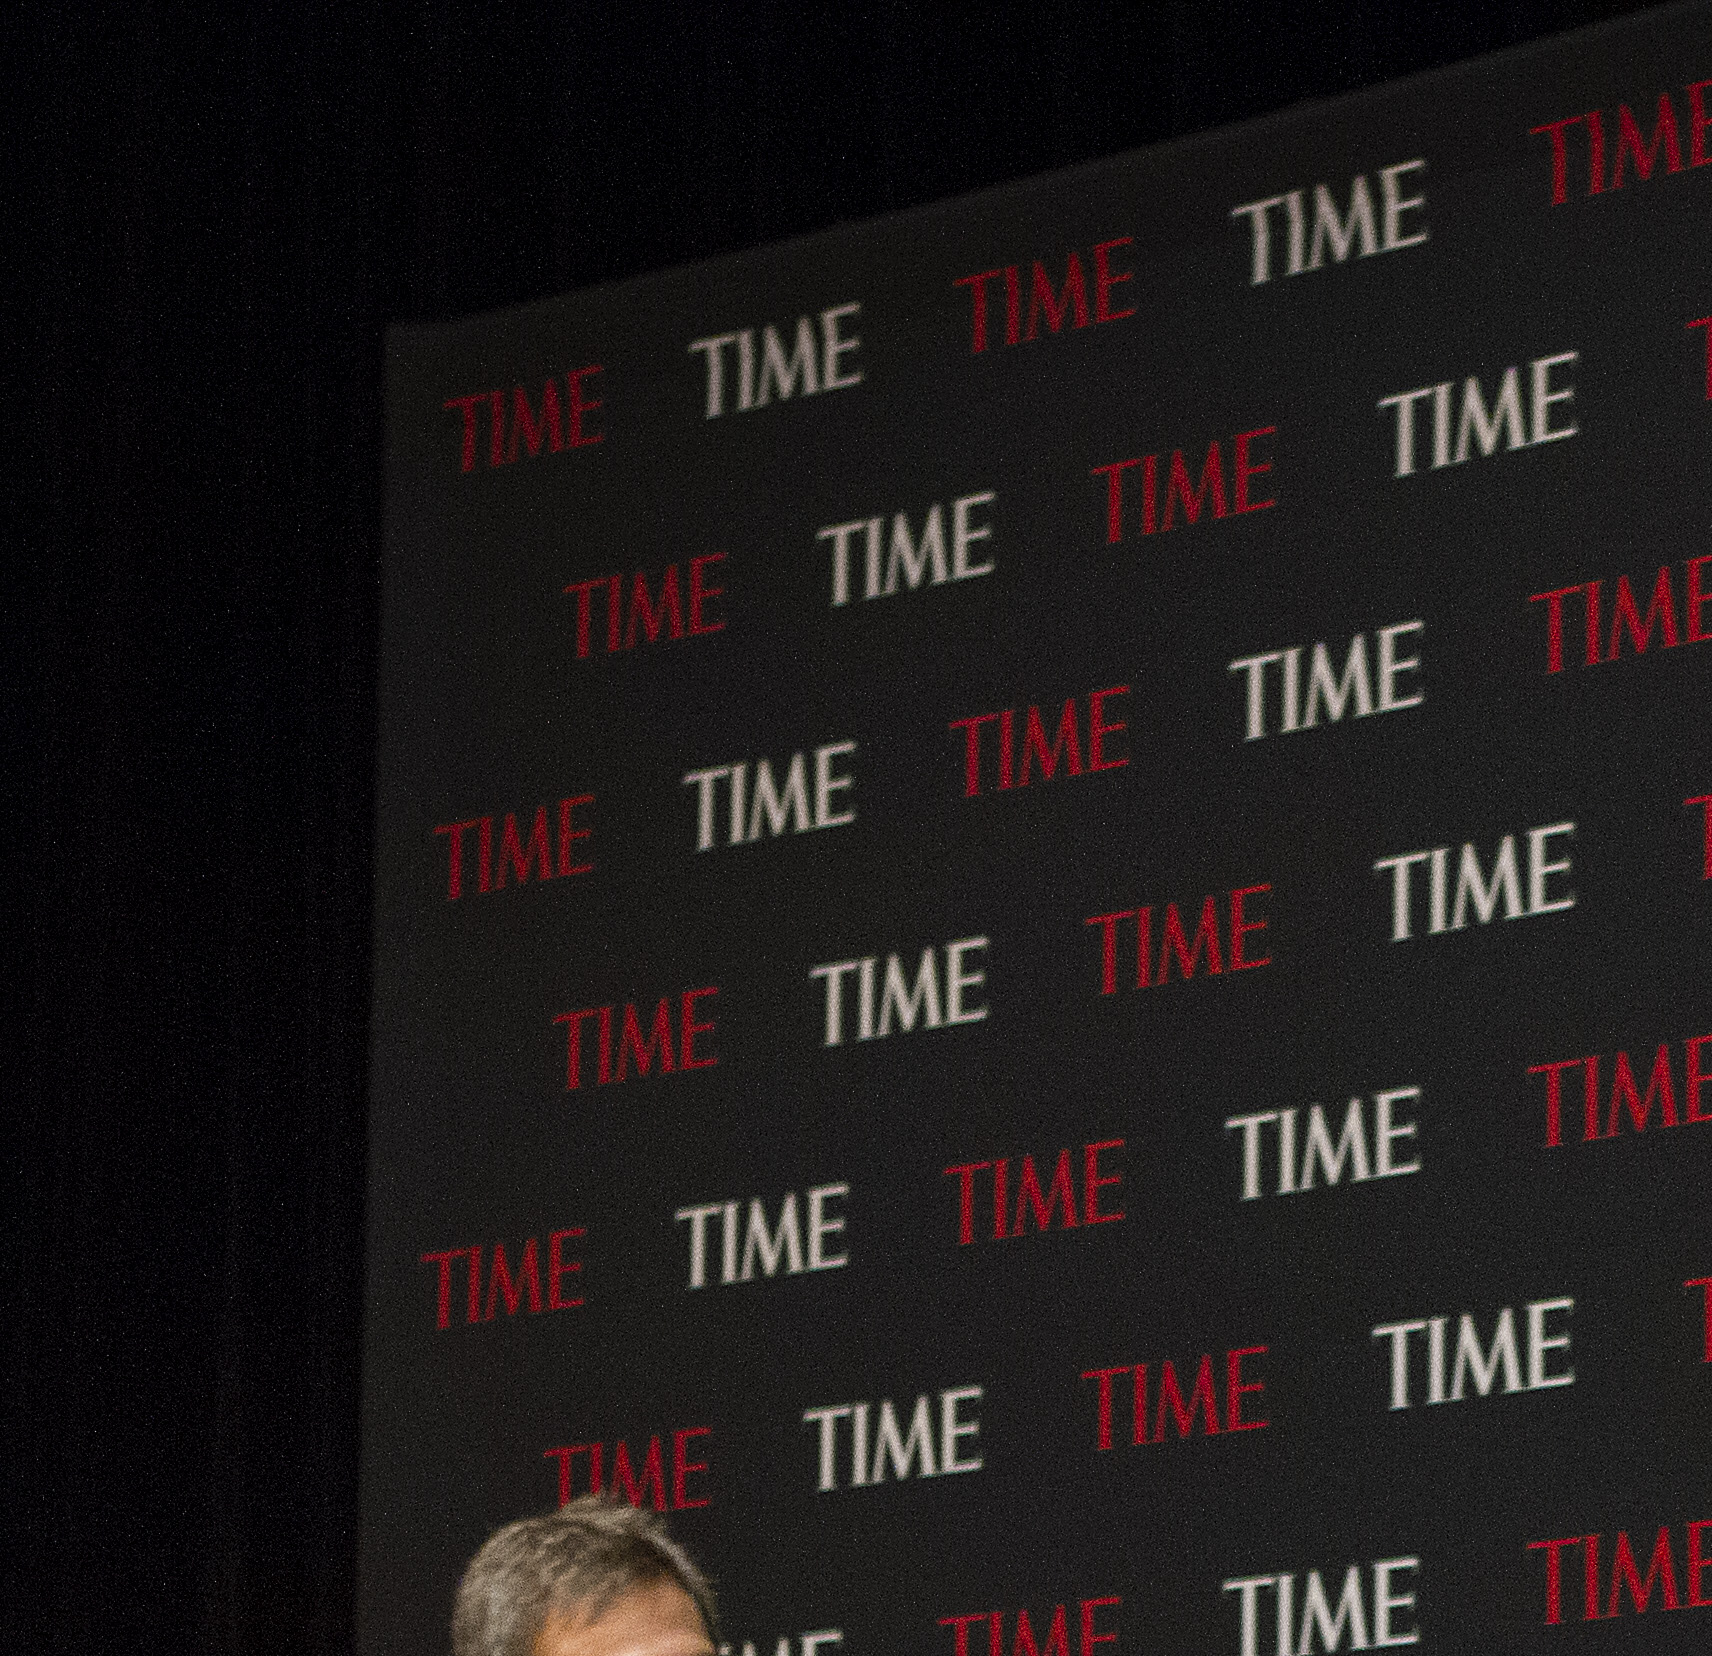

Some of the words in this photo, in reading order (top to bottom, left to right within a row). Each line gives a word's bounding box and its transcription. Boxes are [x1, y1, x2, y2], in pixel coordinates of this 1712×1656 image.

[1231, 160, 1427, 285] TIME
[954, 236, 1135, 353] TIME
[690, 303, 861, 418] TIME
[1378, 351, 1578, 476] TIME
[439, 366, 605, 472] TIME
[1092, 426, 1276, 543] TIME
[818, 492, 994, 605] TIME
[563, 552, 728, 659] TIME
[1229, 621, 1423, 740] TIME
[684, 741, 855, 851] TIME
[950, 685, 1129, 797] TIME
[433, 794, 595, 900] TIME
[1375, 822, 1574, 941] TIME
[810, 936, 988, 1046] TIME
[1086, 883, 1271, 995] TIME
[553, 986, 718, 1090] TIME
[944, 1138, 1125, 1244] TIME
[1225, 1087, 1420, 1199] TIME
[421, 1227, 585, 1329] TIME
[675, 1184, 848, 1288] TIME
[1081, 1345, 1268, 1450] TIME
[1372, 1298, 1574, 1409] TIME
[804, 1386, 983, 1491] TIME
